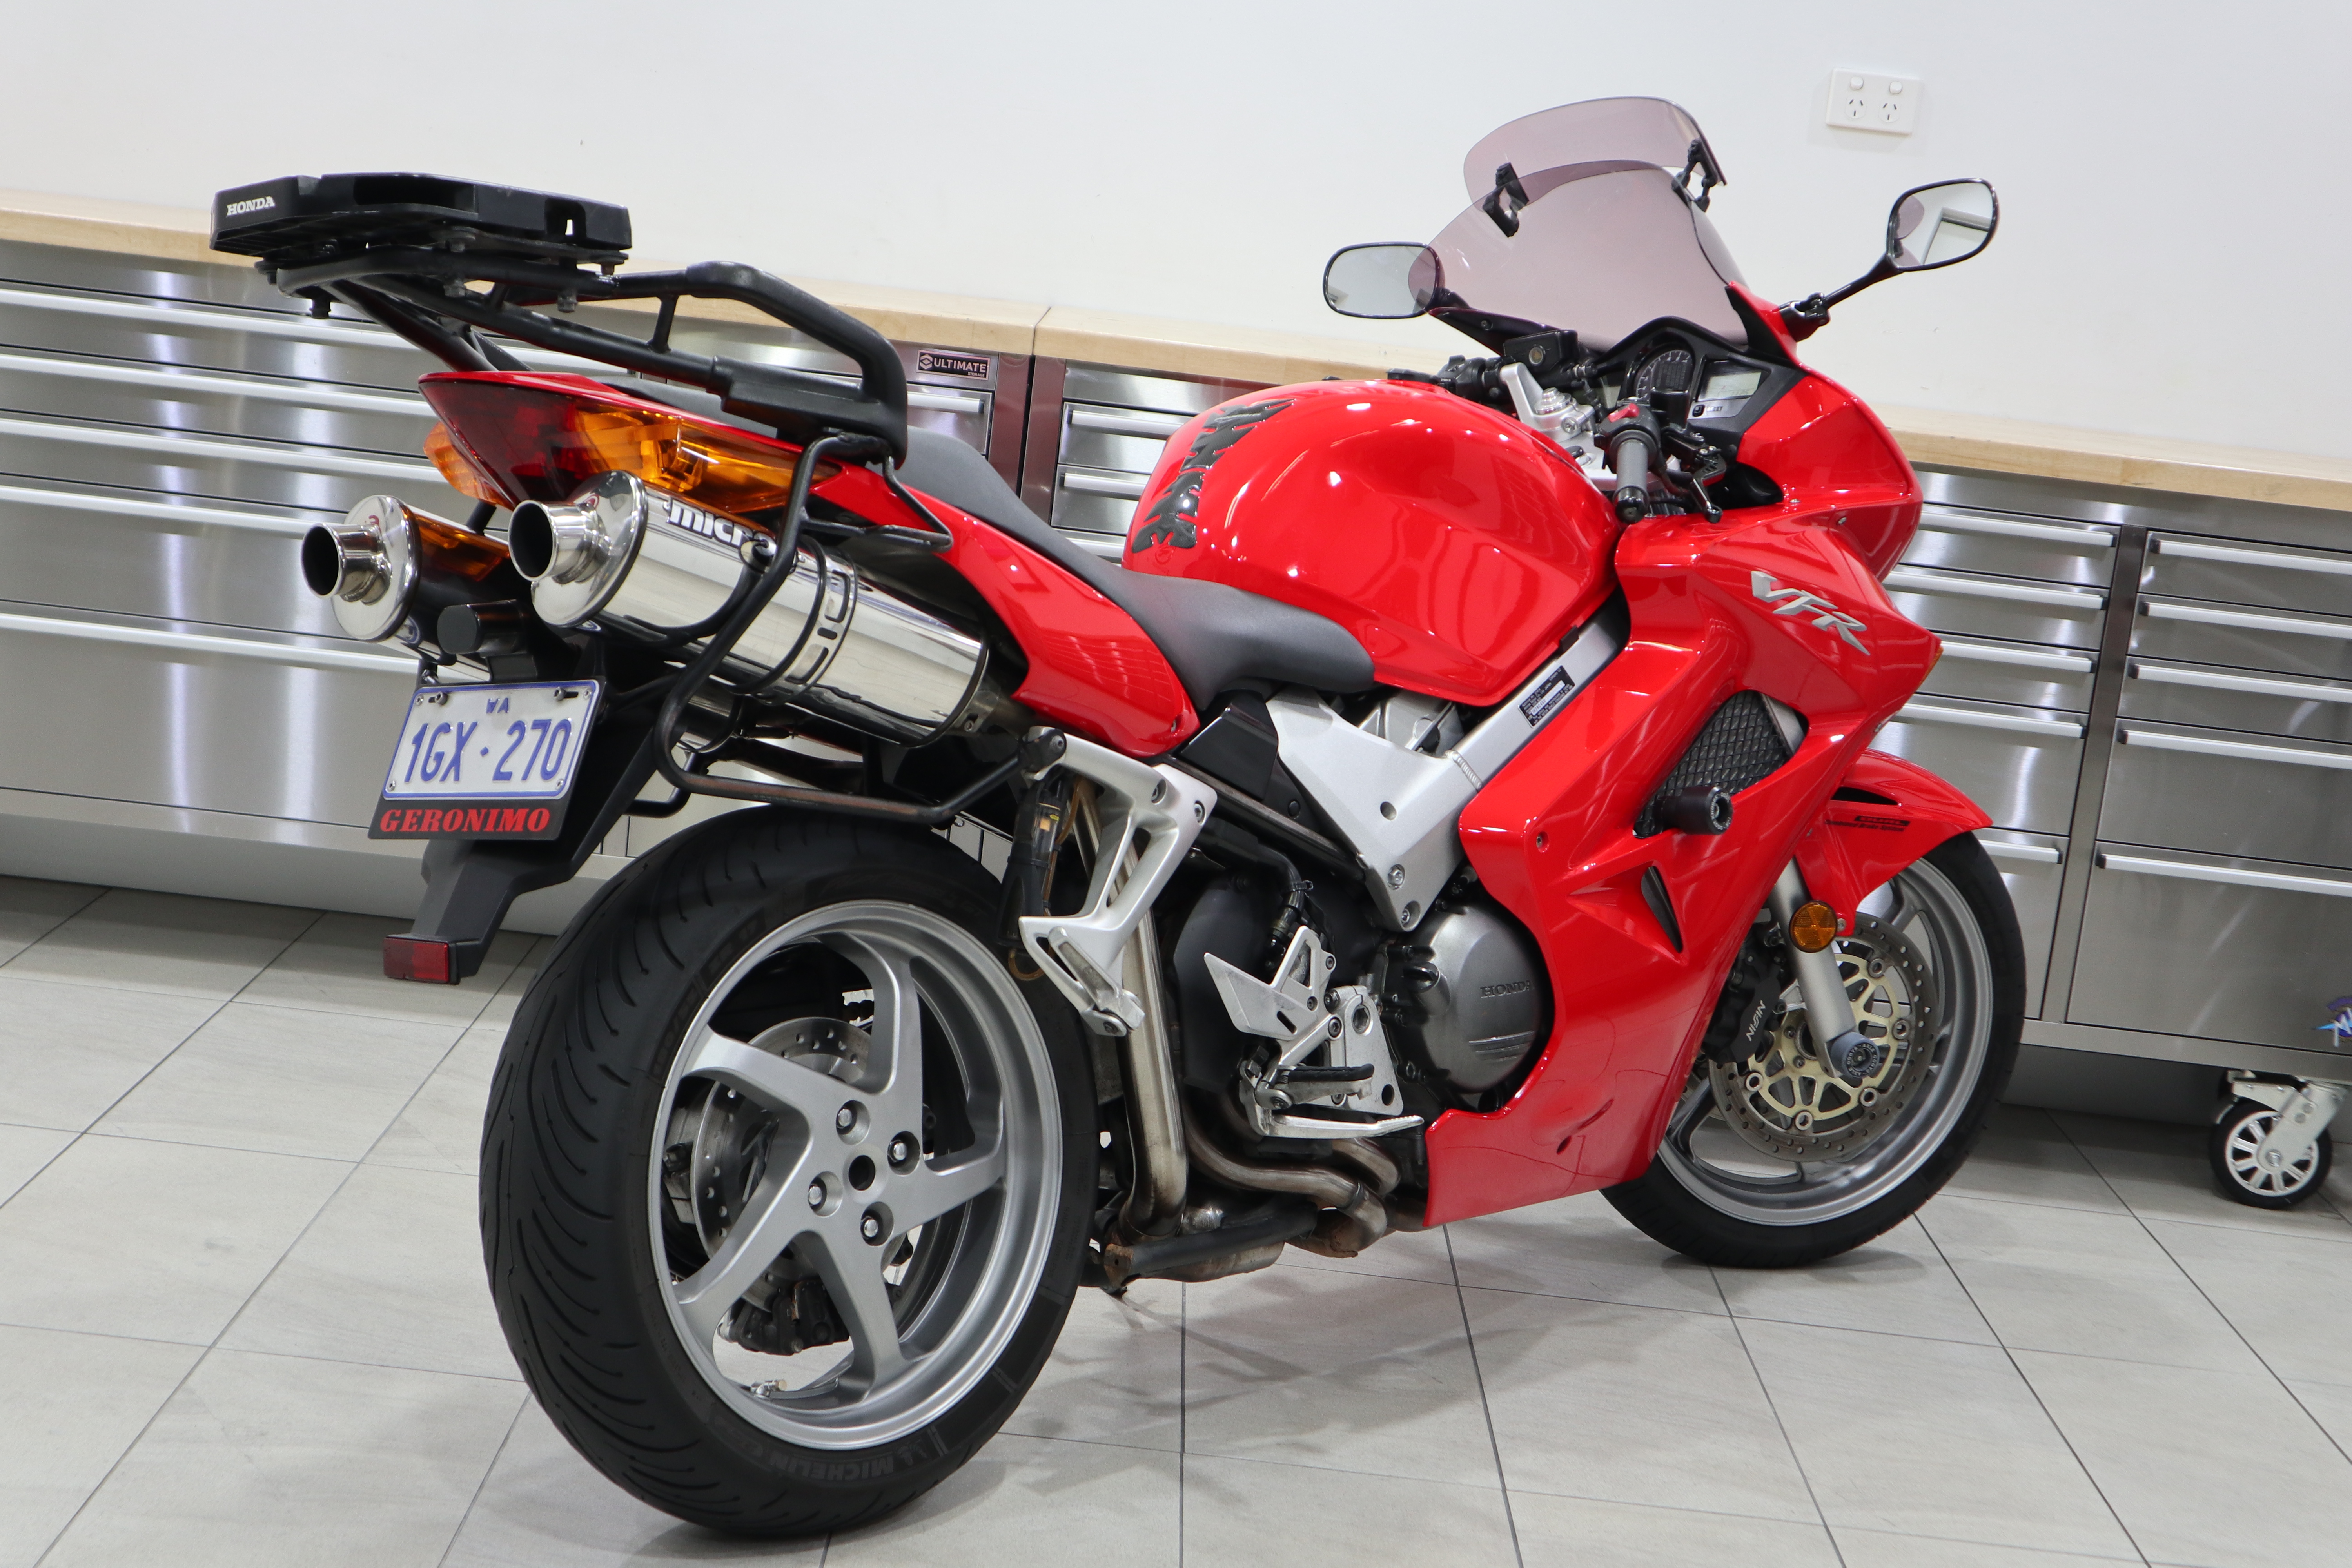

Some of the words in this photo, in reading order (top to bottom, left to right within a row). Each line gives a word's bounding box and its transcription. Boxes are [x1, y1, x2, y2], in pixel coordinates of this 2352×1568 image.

[226, 195, 275, 216] HONDA
[933, 358, 987, 372] ULTIMATE
[1750, 570, 1870, 656] VFR
[486, 697, 509, 713] WA
[379, 808, 550, 832] GERONIMO
[1480, 980, 1534, 998] HONDA
[768, 1450, 893, 1481] MICHELIN
